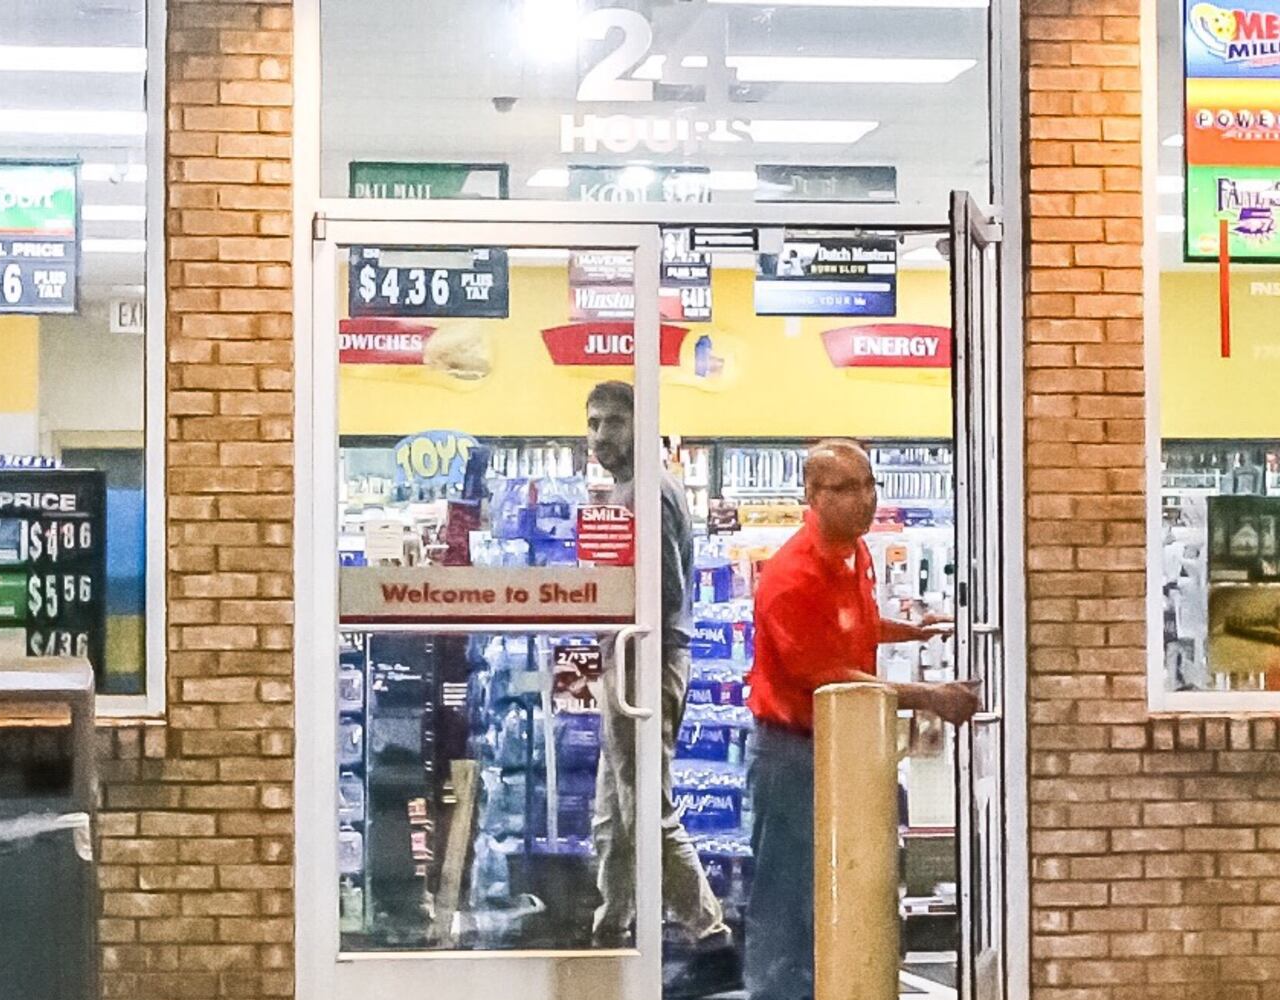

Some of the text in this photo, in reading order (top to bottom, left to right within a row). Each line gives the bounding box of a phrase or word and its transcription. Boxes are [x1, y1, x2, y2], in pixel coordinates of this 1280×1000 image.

[576, 8, 738, 102] 24
[561, 113, 752, 153] HOURS
[12, 243, 65, 257] PRICE
[359, 265, 449, 304] $4.36
[466, 286, 489, 299] TAX
[119, 302, 143, 326] EXI
[339, 333, 422, 351] DWICHES
[584, 334, 634, 355] JUIC
[852, 336, 939, 357] ENERGY
[381, 583, 598, 604] Welcome to Shell
[693, 627, 726, 644] AFINA
